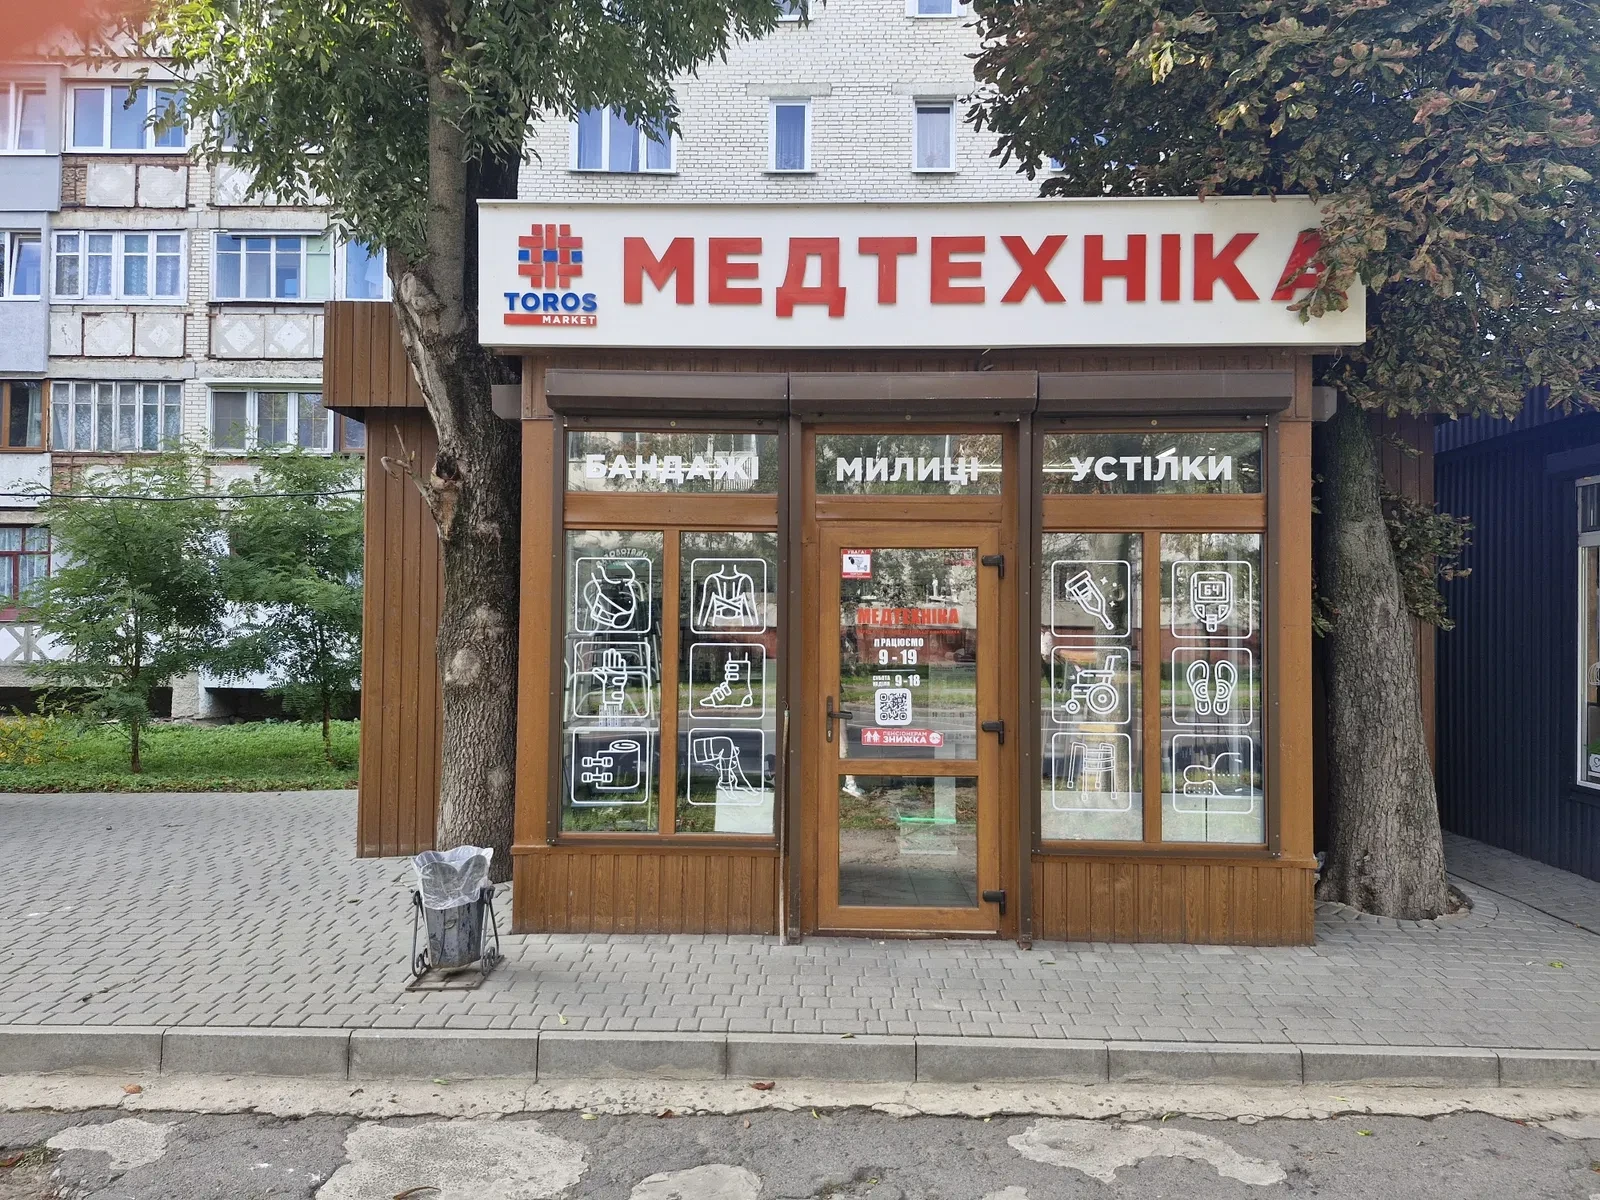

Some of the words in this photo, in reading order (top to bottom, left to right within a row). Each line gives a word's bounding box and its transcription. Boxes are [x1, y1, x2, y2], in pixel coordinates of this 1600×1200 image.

[624, 232, 1348, 317] МЕДТЕХНІКА
[504, 292, 598, 312] TOROS
[542, 314, 597, 325] MARKET
[586, 454, 759, 484] БАНДАЖІ
[836, 456, 979, 486] МИЛИЦІ
[1070, 455, 1233, 482] УСТІЛКИ
[857, 607, 959, 626] МЕДТЕХНІКА
[874, 638, 924, 648] ПРАЦЮЄМО
[883, 736, 927, 744] ЗНИЖКА
